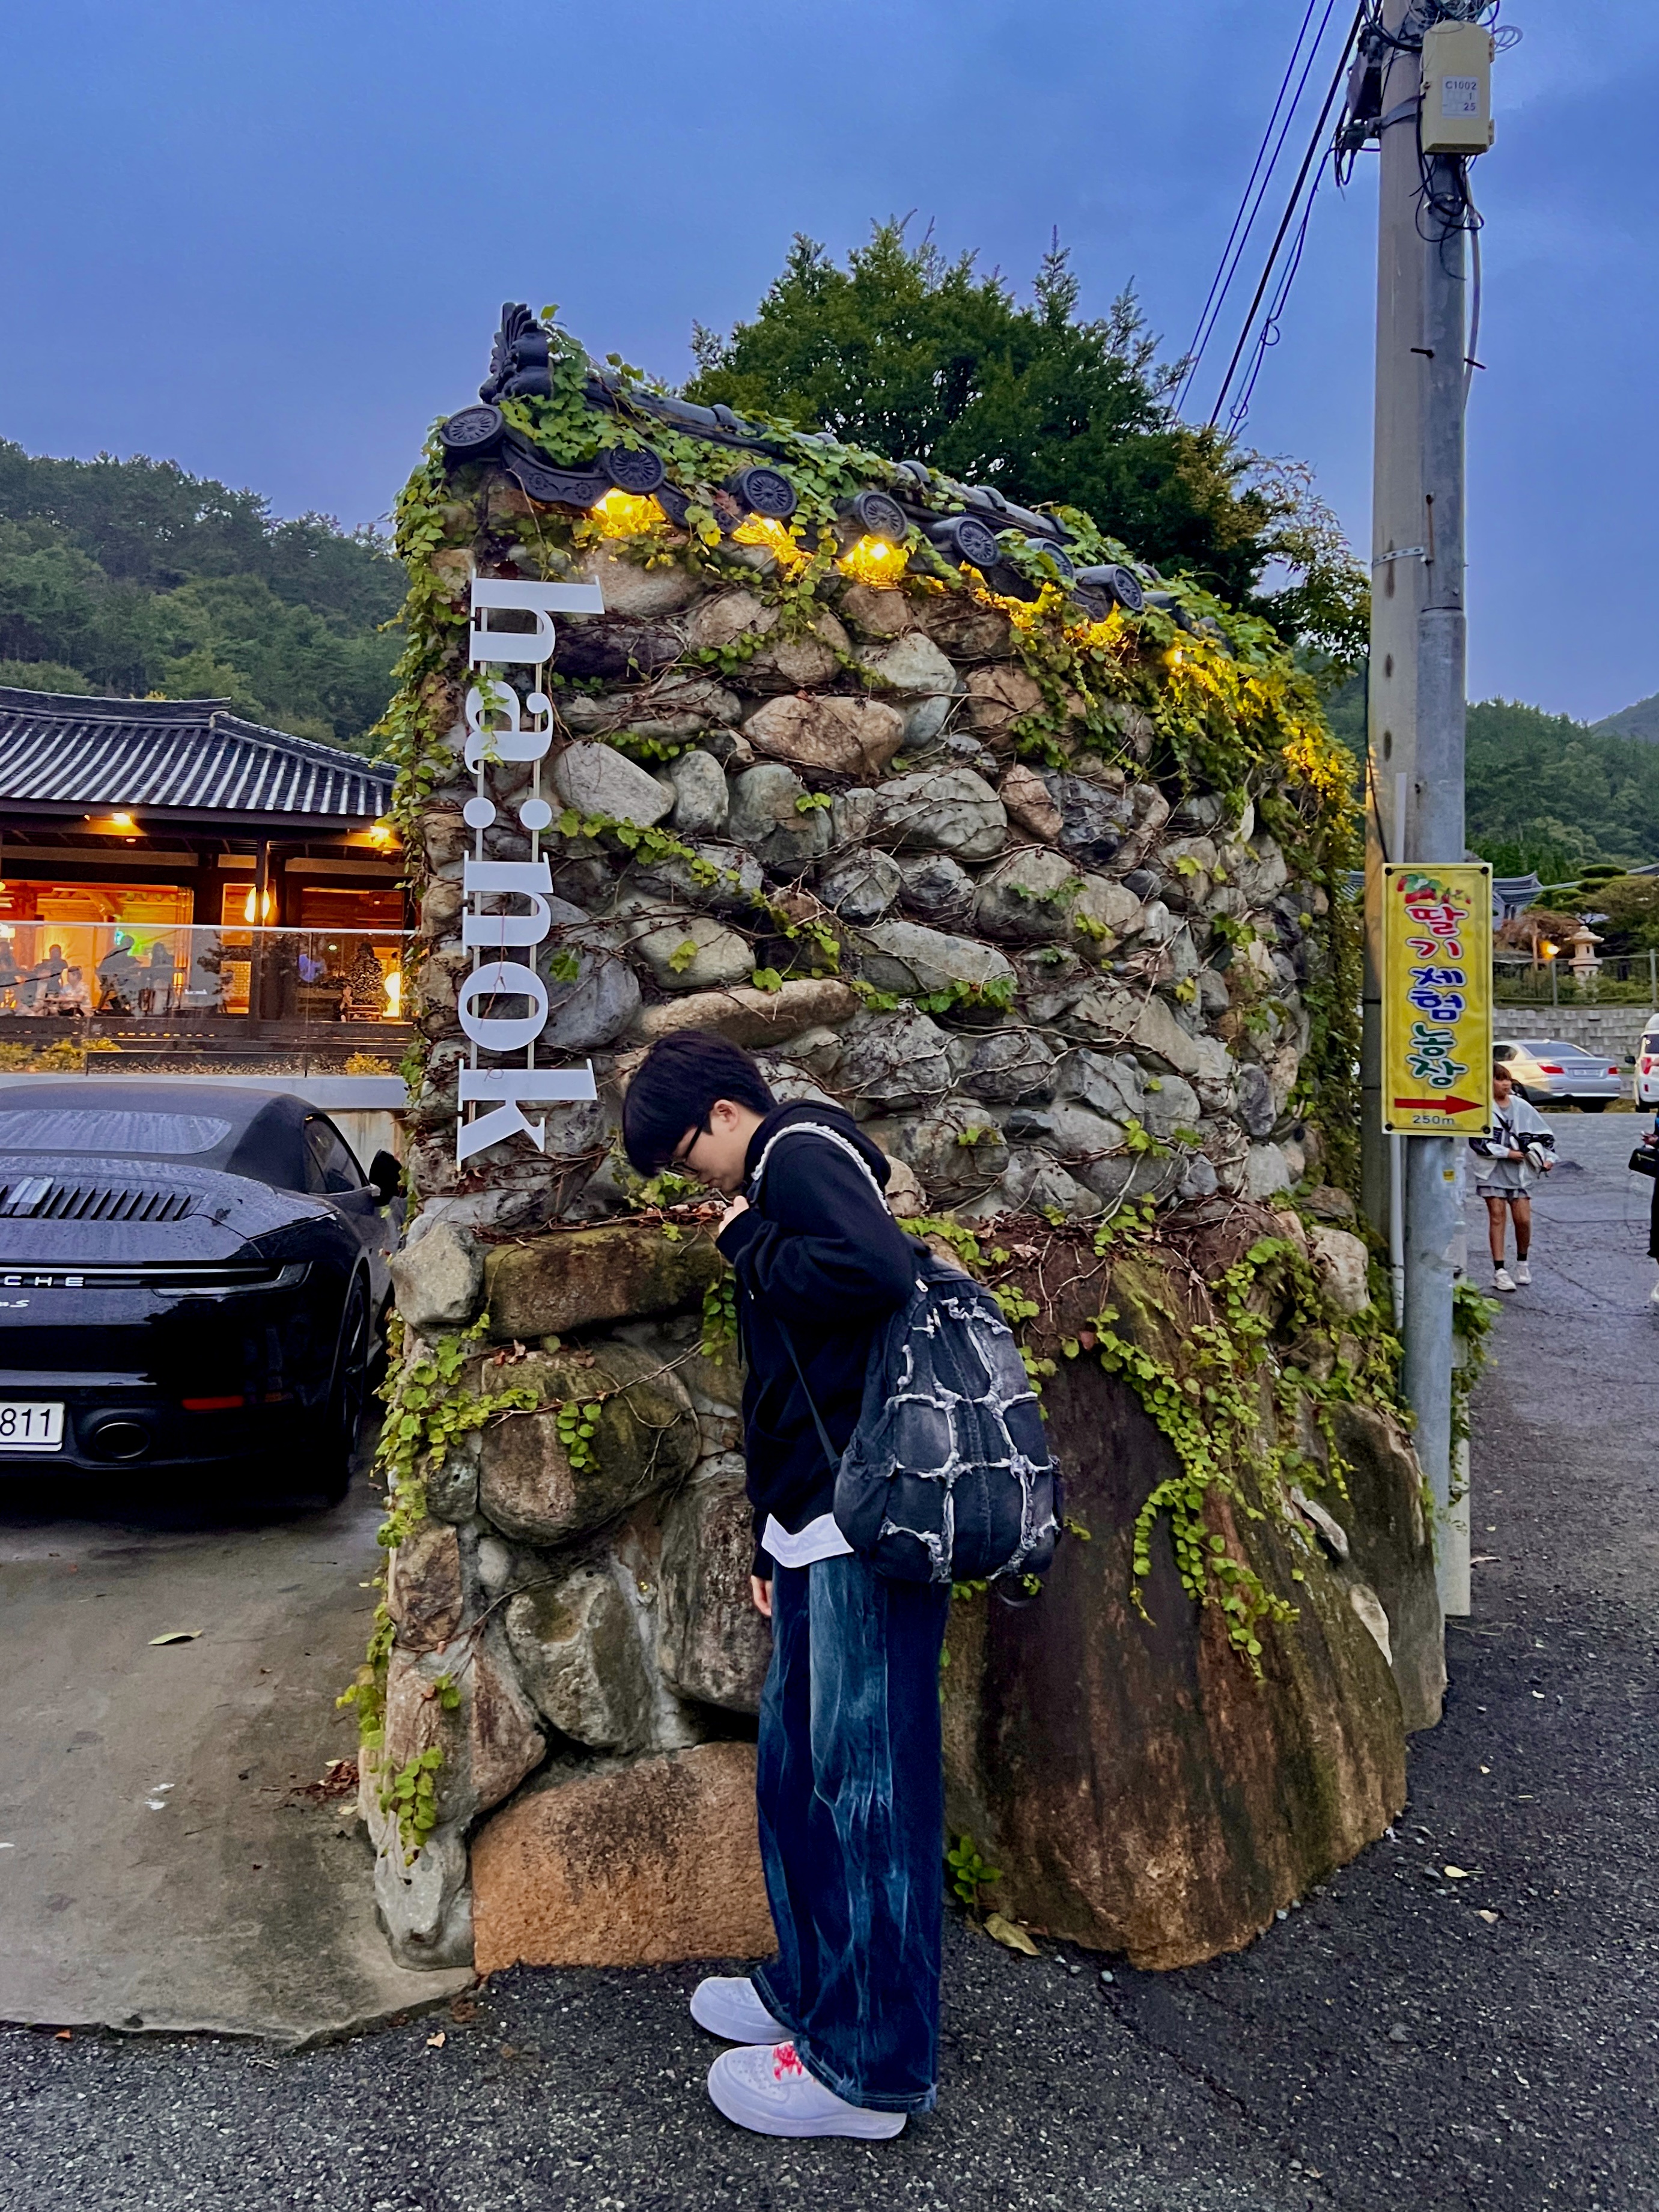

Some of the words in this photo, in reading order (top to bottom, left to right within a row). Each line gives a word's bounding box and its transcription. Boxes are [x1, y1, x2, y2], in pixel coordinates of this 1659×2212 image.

[1445, 81, 1477, 90] C1002
[1464, 102, 1476, 111] 25
[1407, 904, 1467, 958] 딸기
[1409, 966, 1466, 1022] 체험
[1407, 1022, 1467, 1087] 농장
[1413, 1115, 1455, 1125] 250m
[0, 1408, 50, 1437] 811
